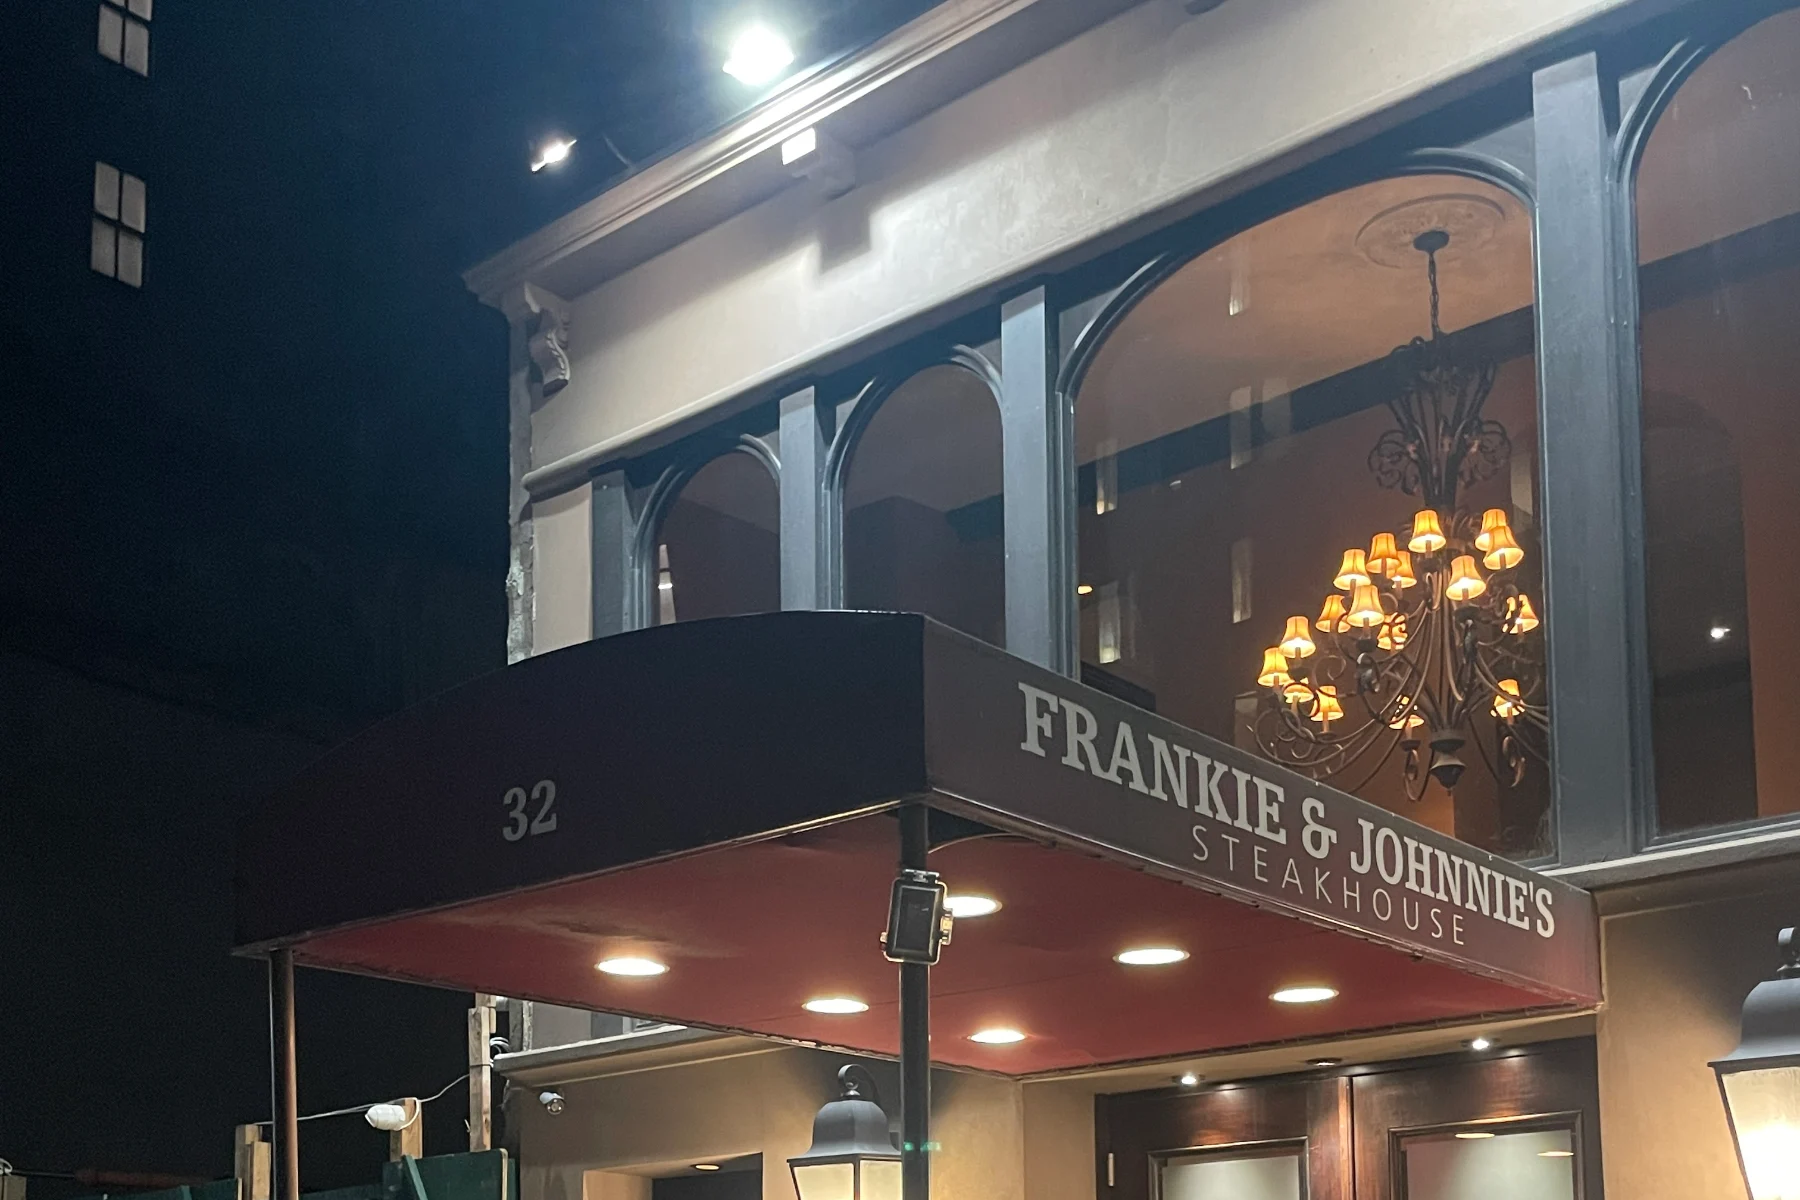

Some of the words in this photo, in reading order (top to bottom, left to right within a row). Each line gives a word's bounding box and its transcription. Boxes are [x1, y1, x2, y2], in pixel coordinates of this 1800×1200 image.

[502, 779, 557, 842] 32
[1018, 682, 1287, 846] FRANKIE
[1301, 797, 1338, 860] &
[1350, 818, 1556, 939] JOHNNIE'S
[1191, 825, 1466, 946] STEAKHOUSE
